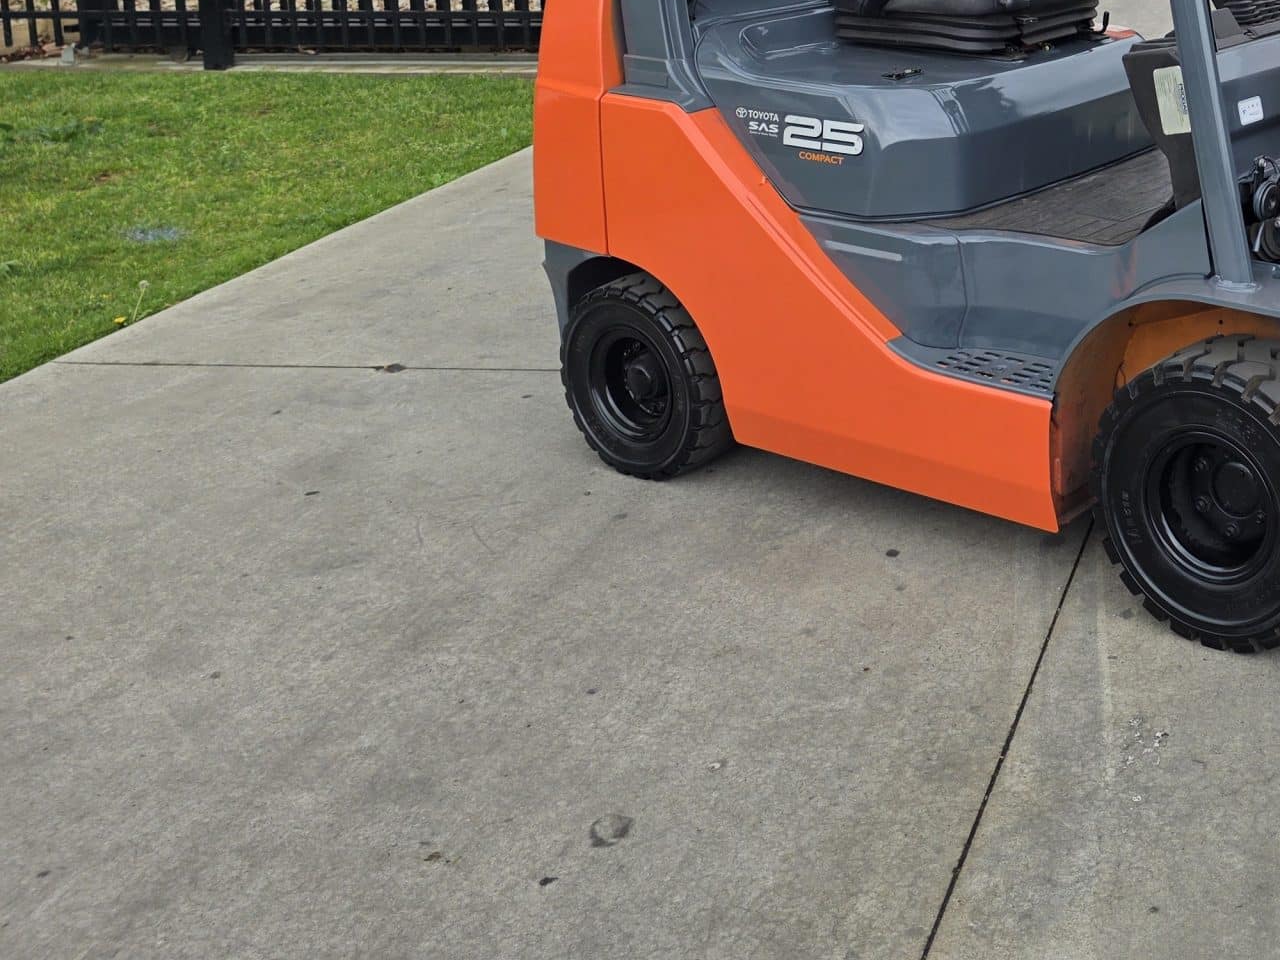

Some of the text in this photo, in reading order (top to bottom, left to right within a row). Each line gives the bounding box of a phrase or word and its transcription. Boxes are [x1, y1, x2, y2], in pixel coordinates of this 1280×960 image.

[748, 109, 780, 122] TOYOTA
[748, 121, 779, 134] SAS
[782, 114, 865, 156] 25
[798, 150, 845, 166] COMPACT
